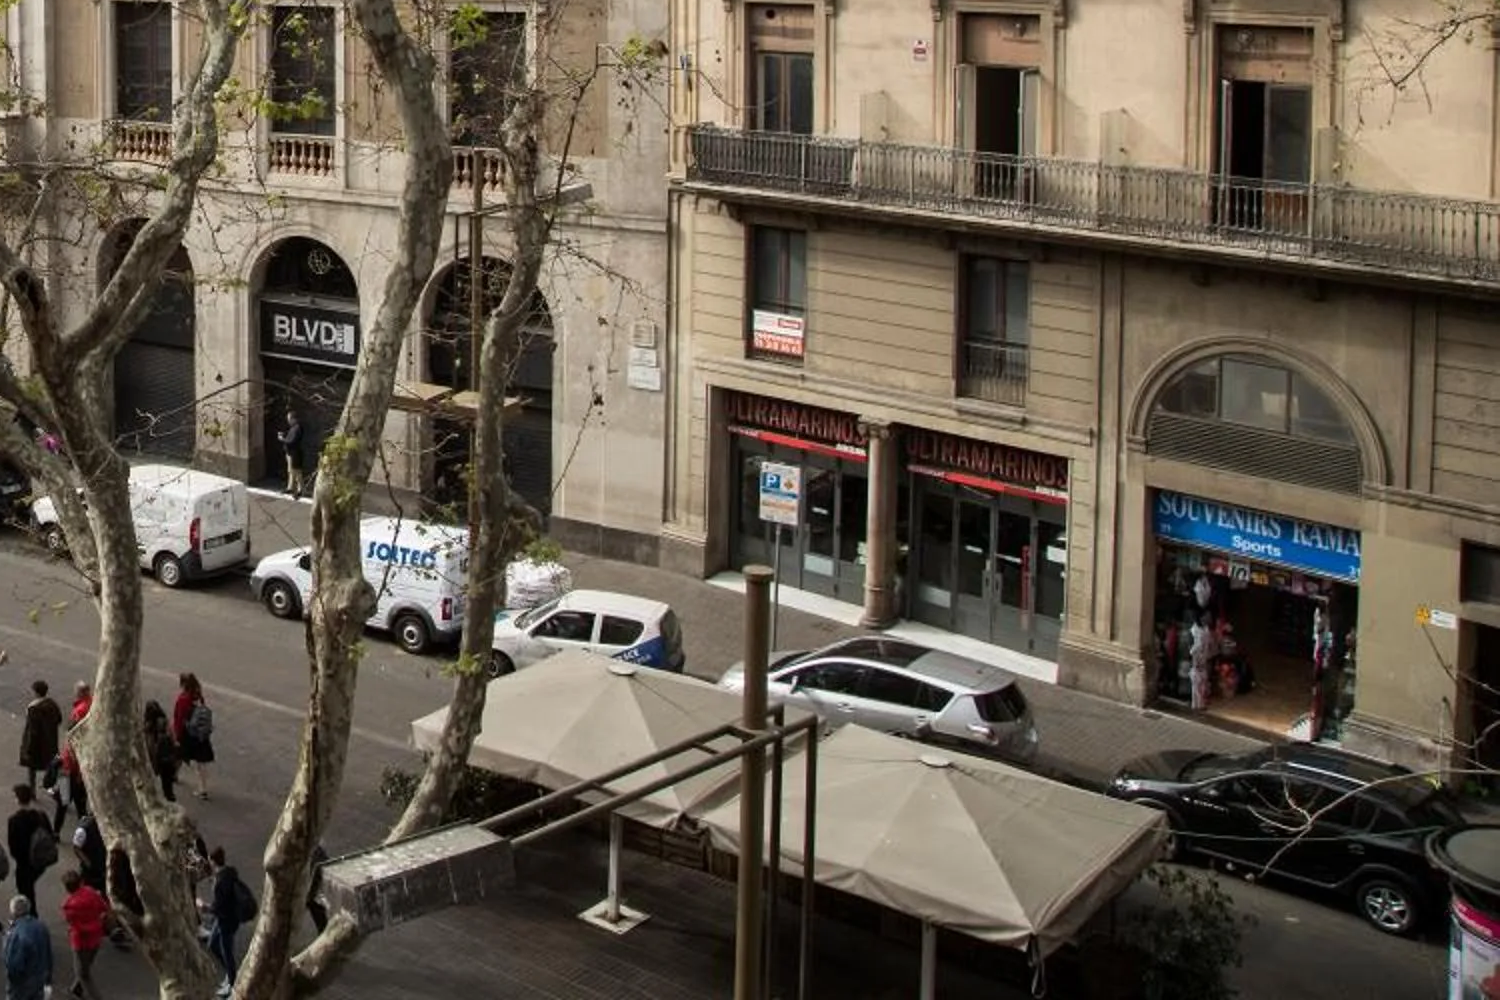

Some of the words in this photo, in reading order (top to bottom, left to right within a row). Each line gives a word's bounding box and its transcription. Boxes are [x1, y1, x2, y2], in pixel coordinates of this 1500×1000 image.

[273, 313, 337, 345] BLVD
[1159, 491, 1282, 539] SOUVENIRS
[1232, 534, 1282, 558] Sports
